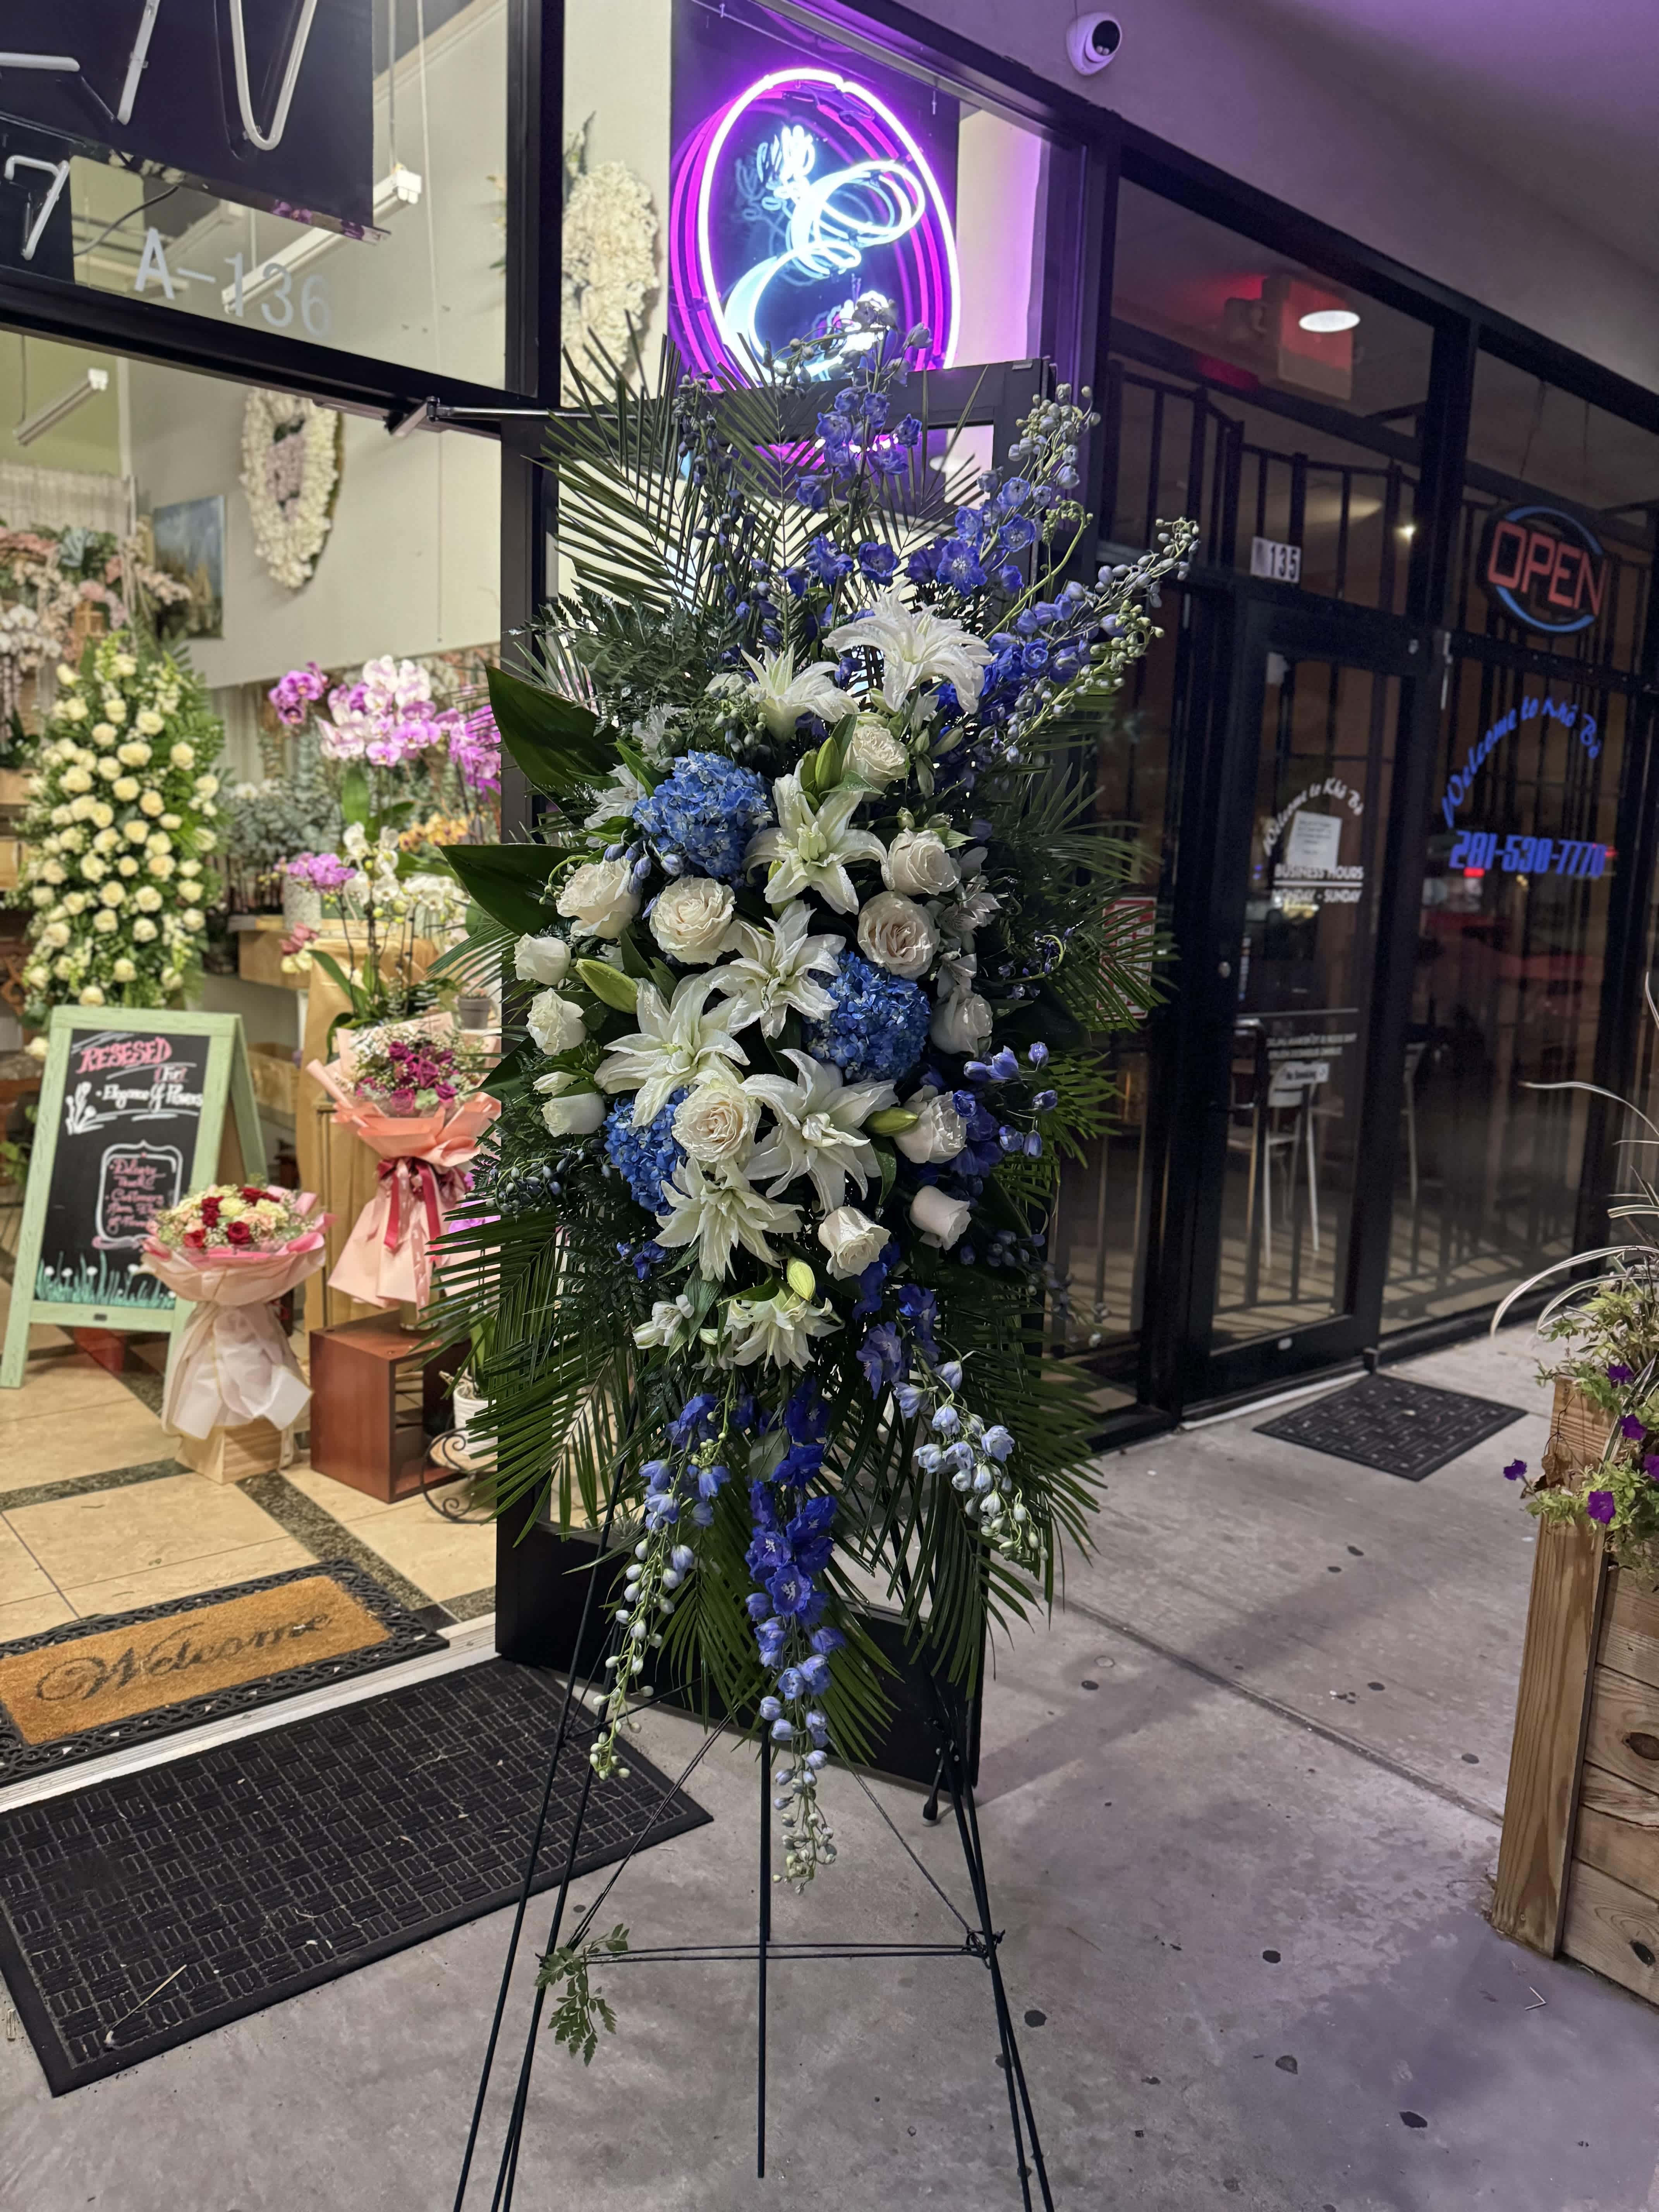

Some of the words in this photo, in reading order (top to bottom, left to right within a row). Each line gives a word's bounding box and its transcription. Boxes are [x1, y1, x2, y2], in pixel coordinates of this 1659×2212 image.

[134, 228, 332, 337] A-136
[1271, 545, 1297, 580] 135
[1488, 520, 1606, 616] OPEN
[1441, 709, 1516, 828] Welcome
[1274, 863, 1324, 879] BUSINESS
[1326, 866, 1364, 880] HOURS
[1323, 889, 1363, 903] SUNDAY
[36, 1613, 334, 1702] Welcome
